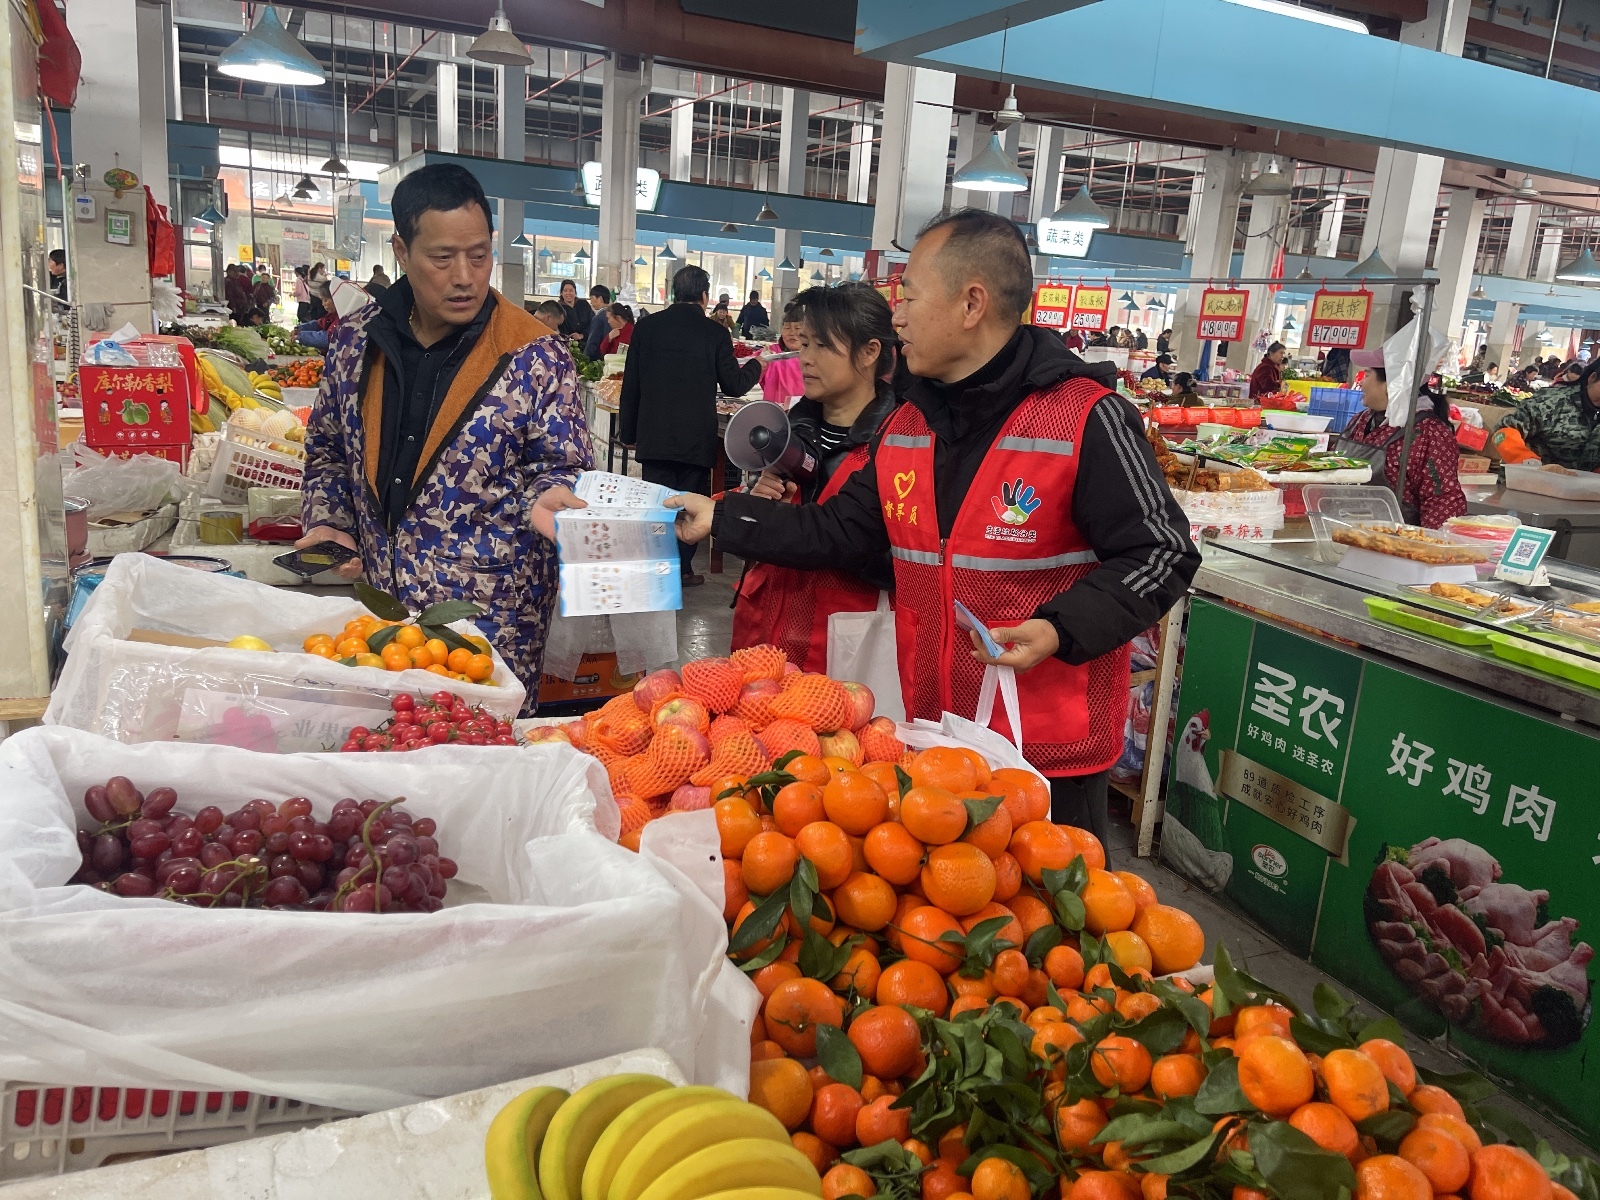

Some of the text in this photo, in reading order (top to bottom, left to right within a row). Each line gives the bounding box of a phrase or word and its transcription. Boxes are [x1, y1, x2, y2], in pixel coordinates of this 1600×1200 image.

[1046, 228, 1084, 246] 蔬菜类
[884, 500, 918, 526] 督导员
[1251, 662, 1345, 749] 圣农
[1247, 723, 1334, 776] 好鸡肉 选圣农
[1241, 784, 1323, 835] 成就安心好鸡肉
[1243, 769, 1326, 819] 89道质检工序
[1386, 732, 1557, 842] 好鸡肉
